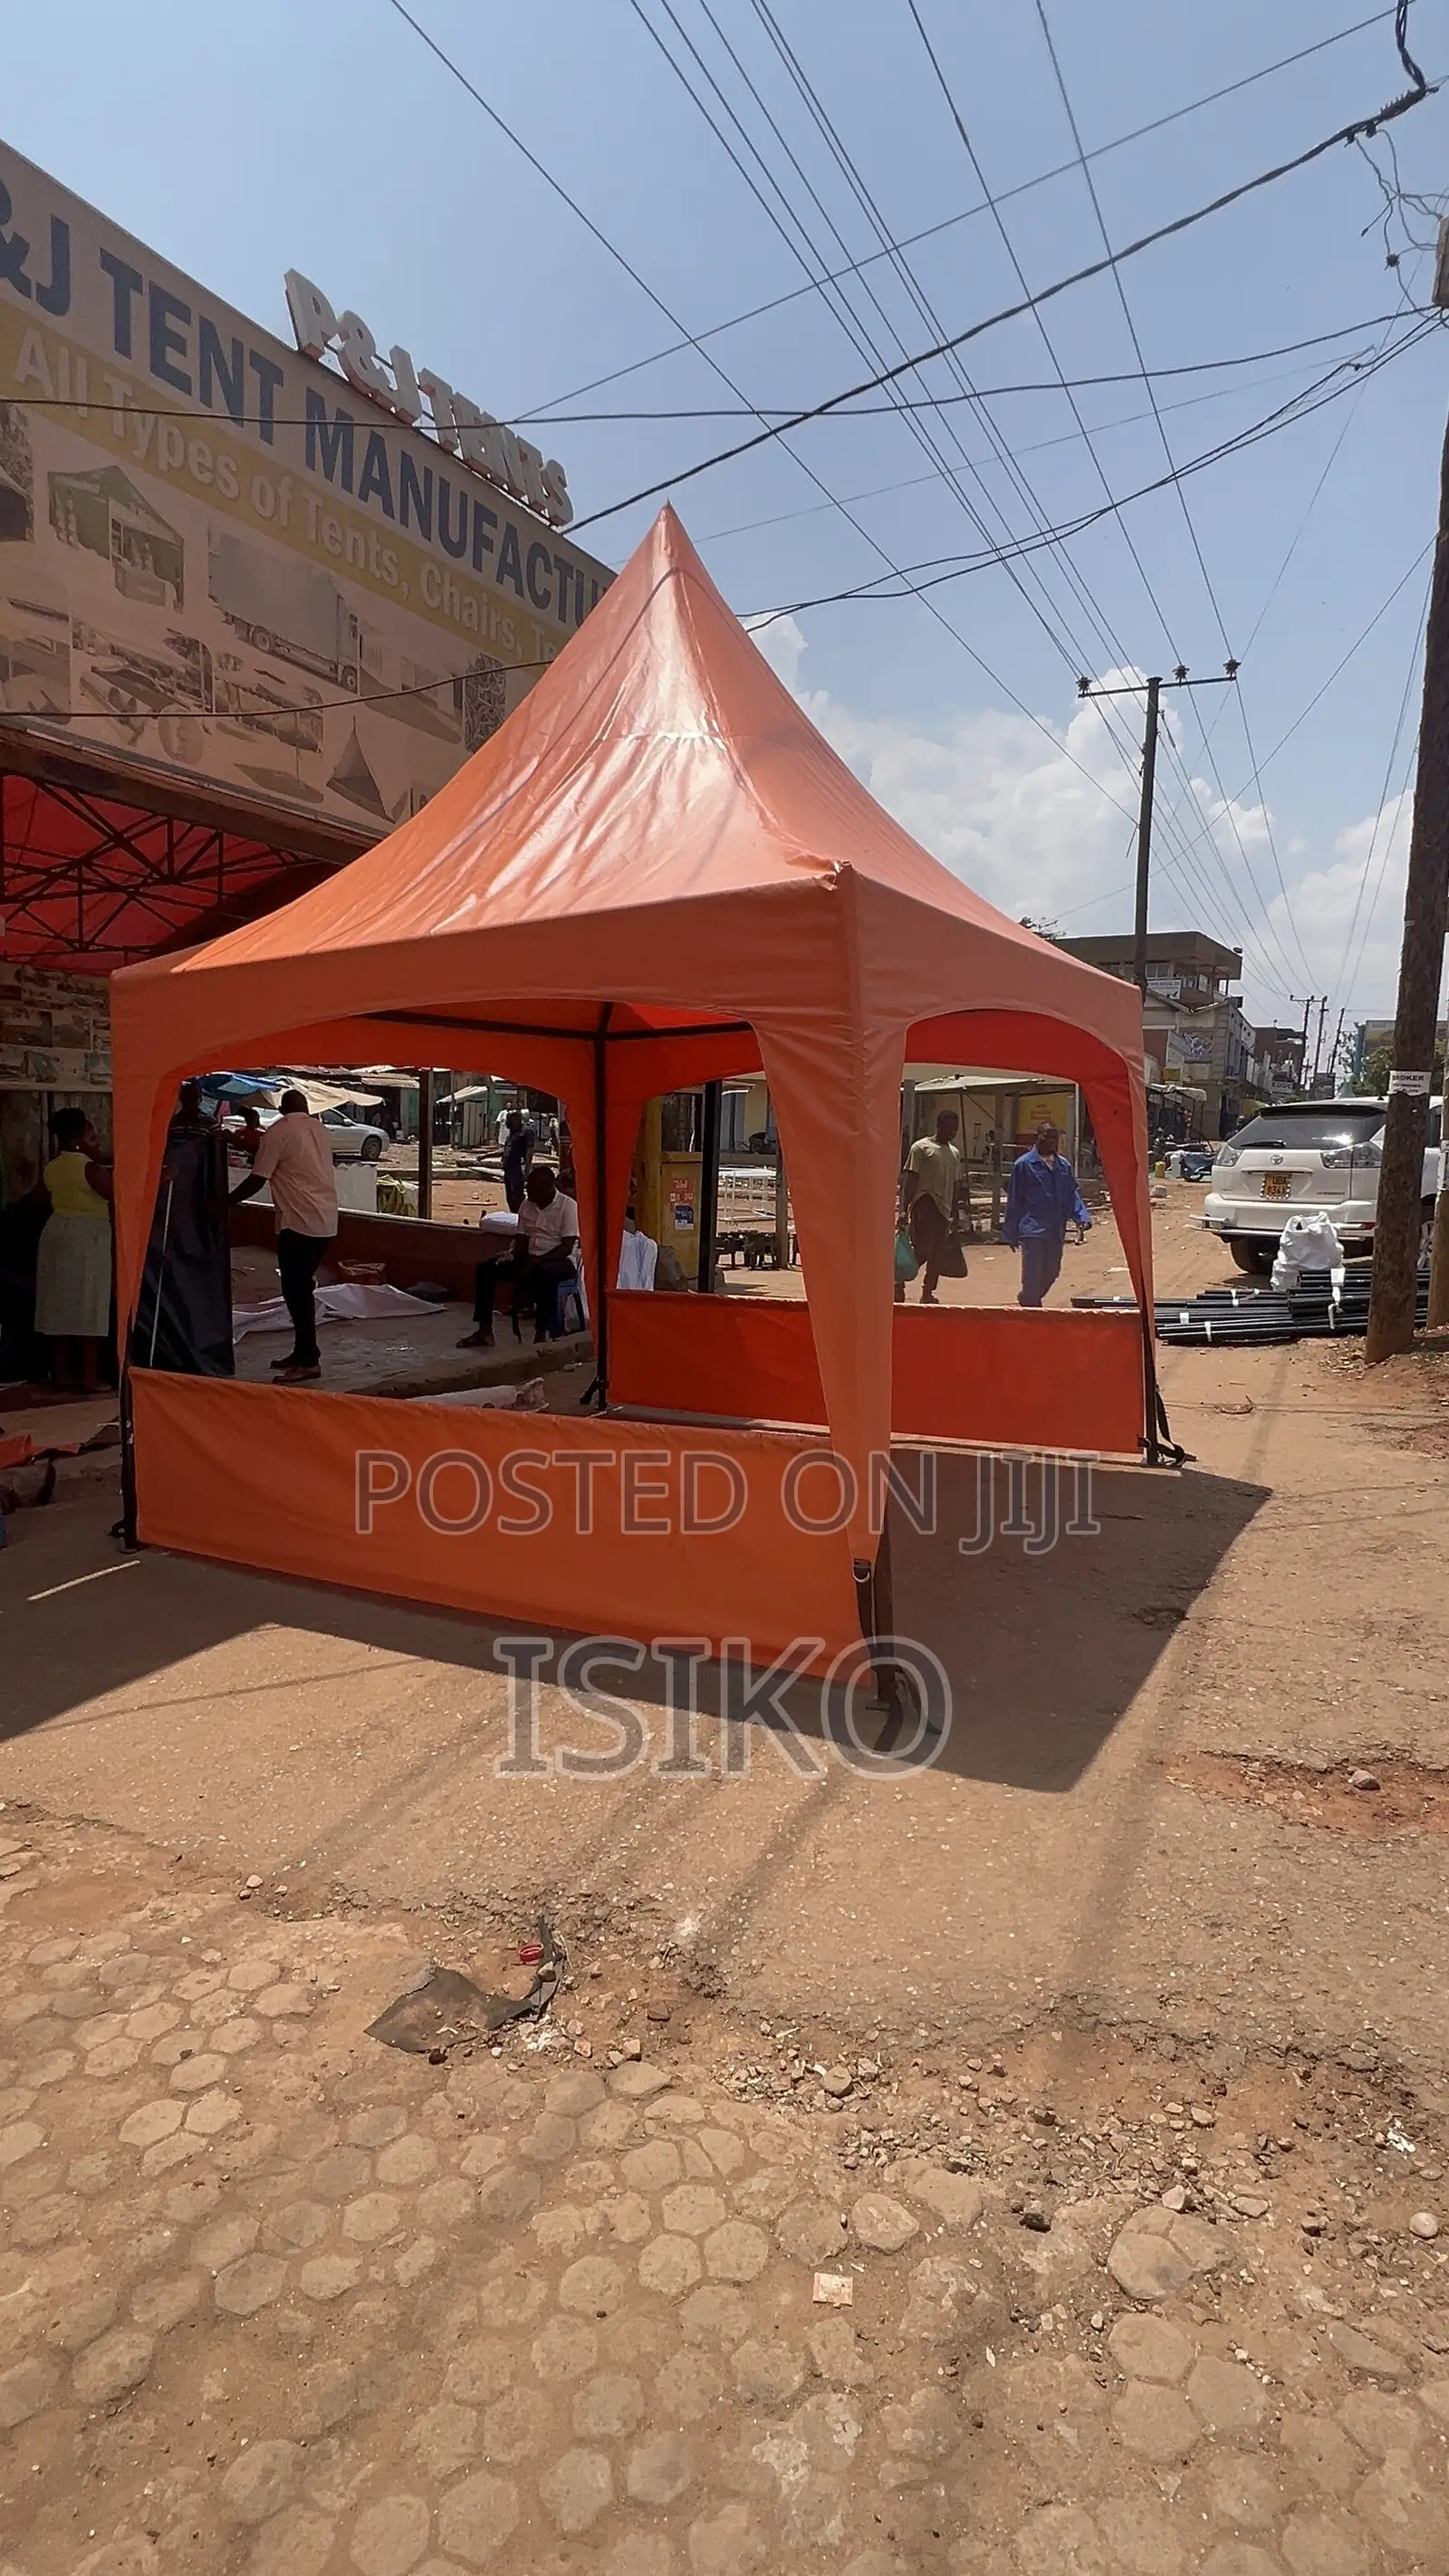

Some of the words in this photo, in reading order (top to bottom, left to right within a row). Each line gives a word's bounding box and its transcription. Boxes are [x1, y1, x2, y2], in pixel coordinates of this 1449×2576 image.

[13, 326, 89, 418] All
[103, 373, 240, 500] Types
[252, 474, 295, 529] of
[301, 489, 409, 601] Tents,
[419, 560, 524, 662] Chairs,
[100, 246, 283, 446] TENT
[305, 387, 607, 629] MANUFACTU
[417, 368, 574, 527] TENTS
